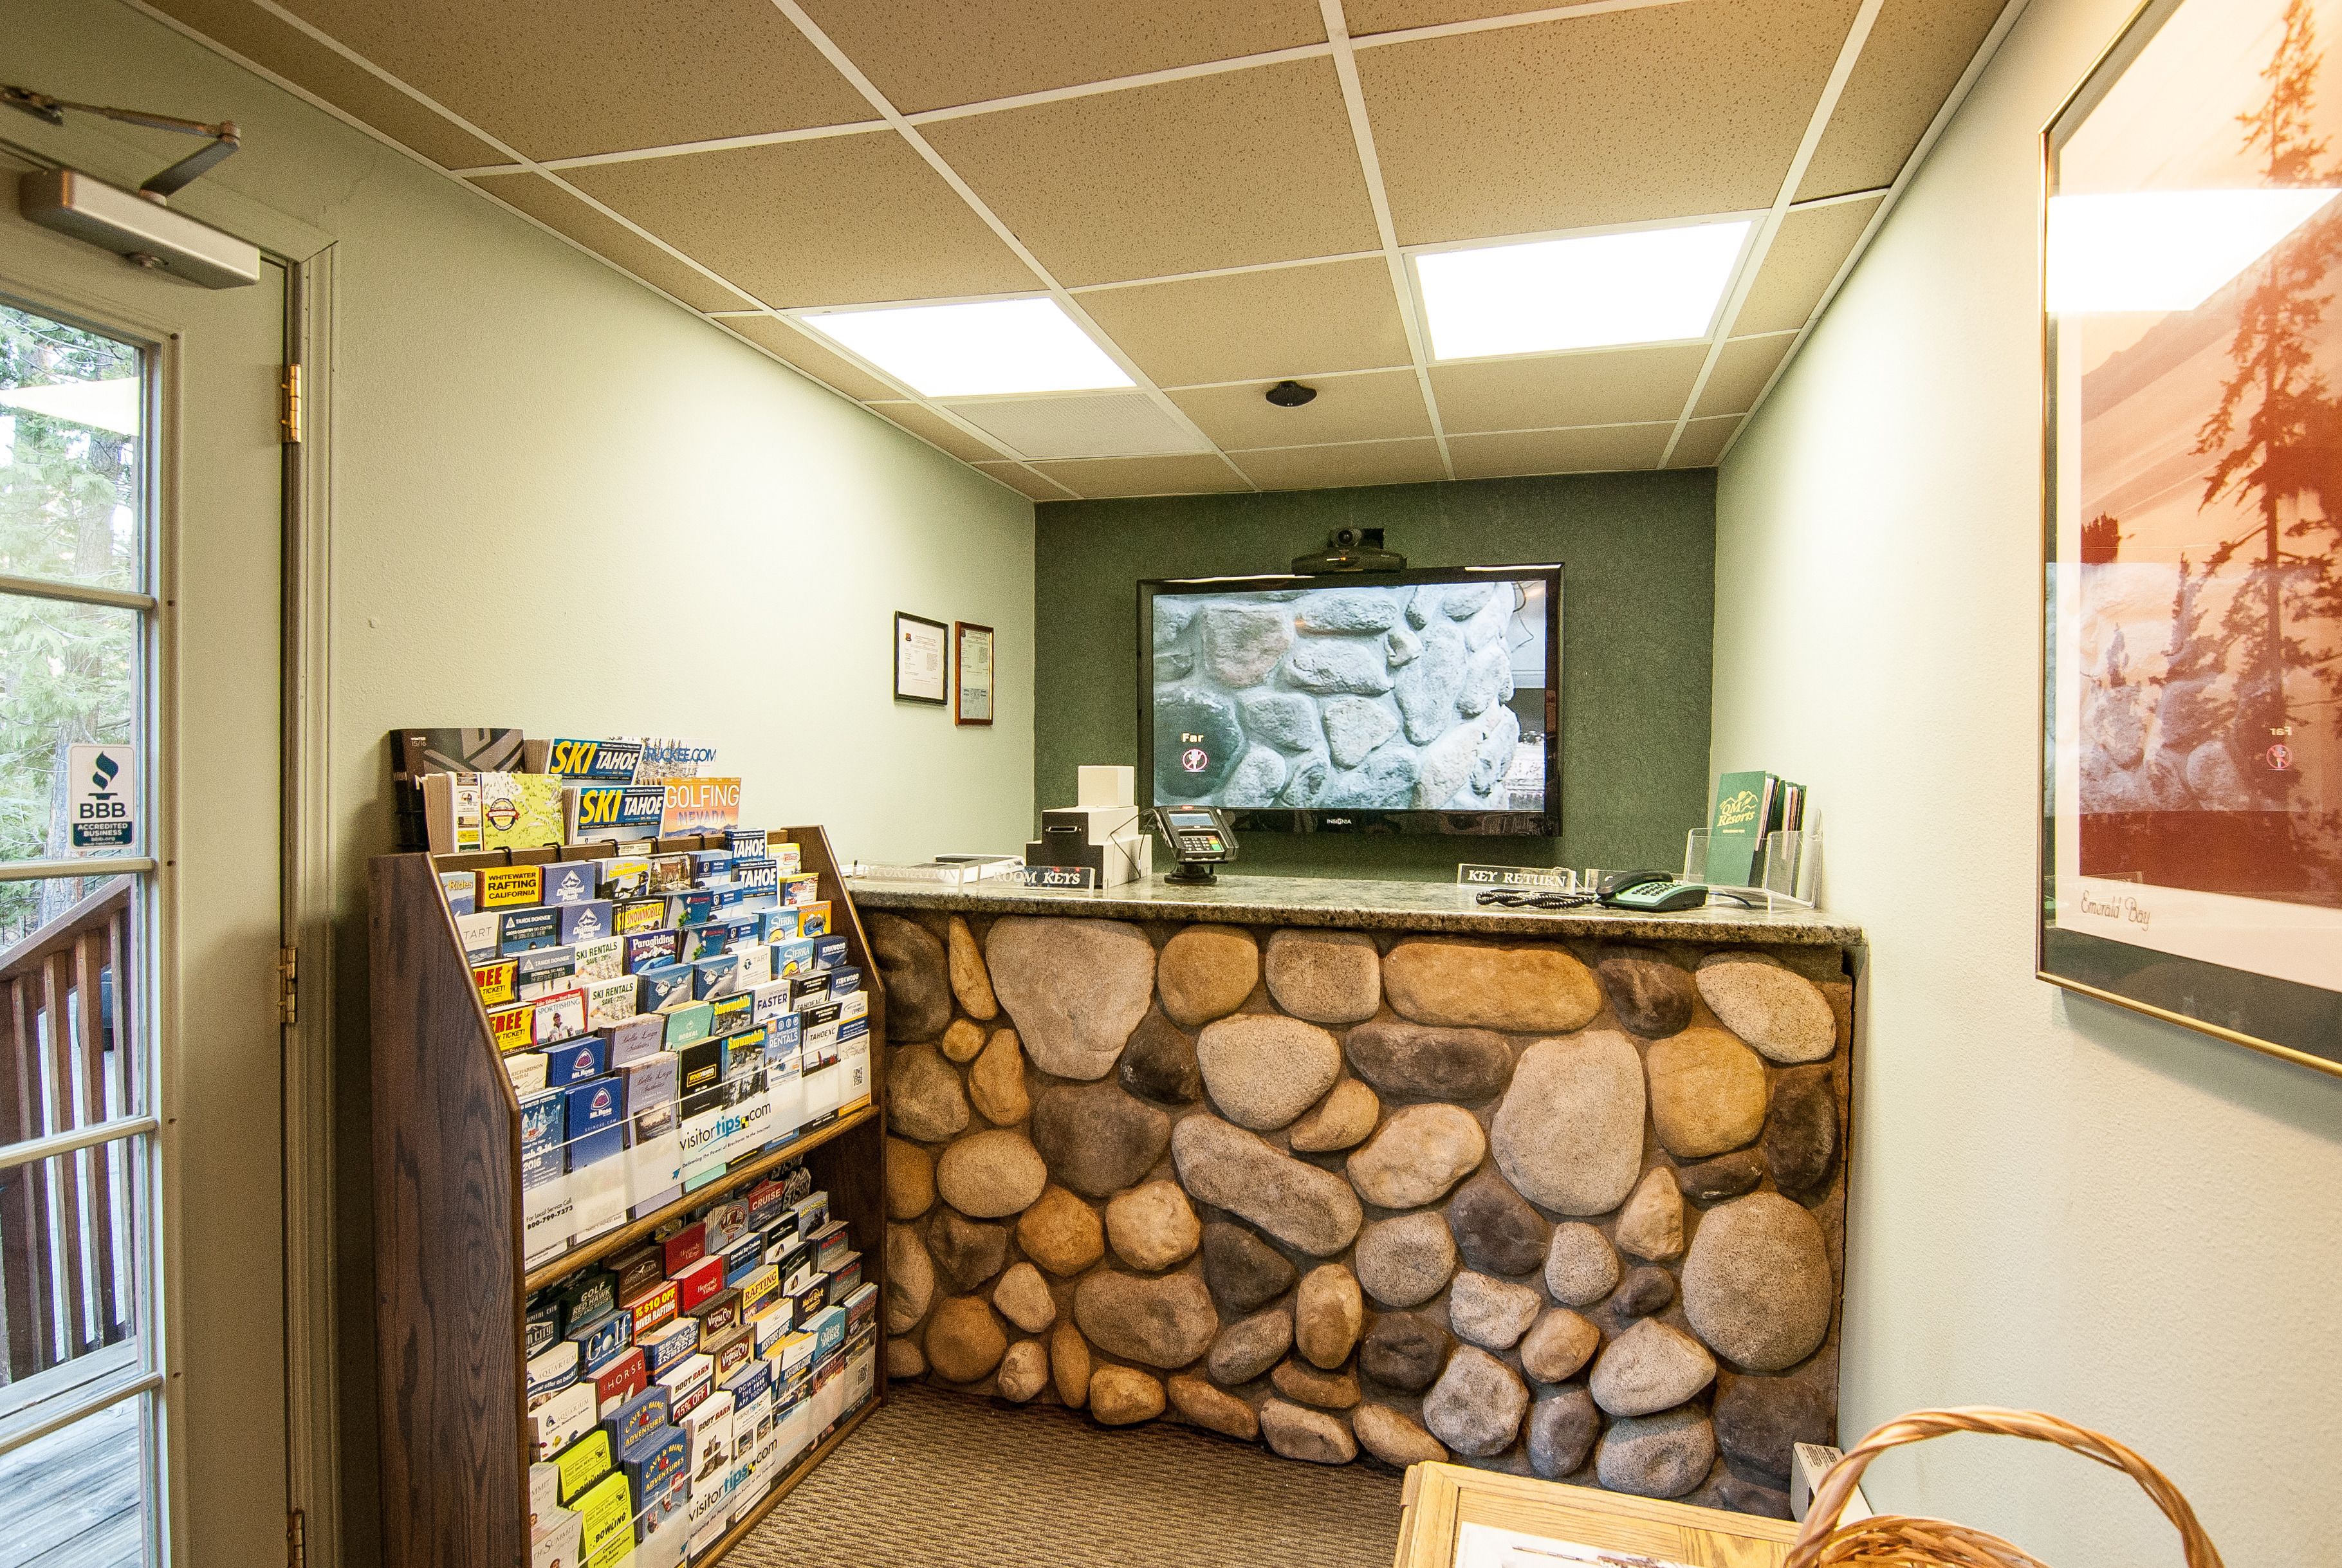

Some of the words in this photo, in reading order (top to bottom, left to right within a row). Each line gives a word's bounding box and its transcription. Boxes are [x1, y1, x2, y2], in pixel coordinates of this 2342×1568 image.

[1182, 732, 1204, 742] Far
[551, 741, 597, 774] SKI
[596, 751, 639, 770] TAHOE
[623, 796, 663, 816] TAHOE
[665, 784, 739, 808] GOLFING
[80, 802, 126, 818] BBB
[580, 789, 623, 824] SKI
[1722, 802, 1742, 816] QM
[678, 809, 726, 826] NEVADA
[1717, 811, 1755, 827] Resorts
[733, 838, 764, 858] TAHOE
[488, 872, 536, 880] WHITEWATER
[609, 863, 649, 878] Snowmobile
[740, 868, 776, 888] TAHOE
[863, 866, 957, 880] INFORMATION
[993, 870, 1037, 883] ROOM
[1043, 871, 1081, 885] KEYS
[1467, 869, 1498, 882] KEY
[1502, 872, 1567, 887] RETURN
[448, 880, 473, 891] Rides
[488, 880, 536, 890] RAFTING
[489, 890, 535, 899] CALIFORNIA
[557, 885, 584, 897] Diamond
[627, 905, 663, 924] SNOWMOBILE!
[2081, 890, 2122, 919] Emerald
[2125, 896, 2150, 932] Bay
[463, 927, 492, 940] TART
[573, 923, 601, 935] Diamond
[576, 950, 587, 961] SKI
[589, 941, 618, 957] RENTALS
[632, 935, 675, 950] Paragliding
[822, 943, 845, 954] KIRKWOOD
[753, 953, 768, 963] TART
[475, 966, 503, 988] REE
[836, 973, 859, 985] KIRKWOOD
[483, 985, 505, 994] TICKET!
[593, 989, 604, 1000] SKI
[605, 982, 634, 997] RENTALS
[538, 999, 580, 1015] SPORTFISHING
[714, 995, 751, 1016] Snowmobile
[757, 993, 788, 1010] FASTER
[490, 1011, 522, 1033] FREE
[503, 1029, 525, 1039] TICKET!
[678, 1031, 698, 1040] BOREAL
[728, 1029, 765, 1051] Snowmobile
[769, 1032, 798, 1049] RENTALS
[511, 1062, 544, 1076] RICHARDSON
[689, 1067, 715, 1081] WOODWARD
[679, 1102, 771, 1152] visitortips.com
[682, 1156, 702, 1168] Delivering
[710, 1147, 722, 1156] Power
[727, 1138, 745, 1148] Brochures
[523, 1158, 542, 1172] 2016
[535, 1208, 546, 1219] Local
[546, 1203, 562, 1214] Service
[562, 1197, 572, 1207] Call
[752, 1188, 781, 1211] CRUISE
[527, 1204, 573, 1231] 800-799-7373
[582, 1282, 605, 1302] GOLF
[697, 1277, 717, 1293] Heavenly
[745, 1271, 777, 1302] RAFTING
[573, 1302, 587, 1316] RED
[589, 1288, 611, 1307] HAWK
[644, 1296, 660, 1313] $10
[661, 1287, 675, 1304] OFF
[636, 1313, 652, 1331] RIVER
[652, 1300, 676, 1321] RAFTING
[708, 1313, 723, 1328] Virginia
[723, 1307, 733, 1321] City
[587, 1313, 631, 1361] Golf
[658, 1337, 696, 1365] INSIDE
[722, 1350, 739, 1367] Virginia
[738, 1342, 748, 1356] City
[539, 1353, 577, 1379] AQUARIUM
[607, 1360, 643, 1390] HORSE
[528, 1385, 544, 1397] pecial
[544, 1379, 555, 1388] offer
[562, 1368, 576, 1382] back!
[675, 1376, 692, 1394] BOOT
[693, 1363, 710, 1383] BARN
[738, 1368, 768, 1394] DOWNLOAD
[742, 1387, 751, 1397] THE
[753, 1378, 766, 1391] FREE
[675, 1399, 692, 1419] 15%
[692, 1387, 707, 1405] OFF
[739, 1397, 750, 1408] APP
[750, 1383, 768, 1399] TODAY!
[557, 1398, 589, 1421] AQUARIUM
[625, 1410, 641, 1434] CAVE
[648, 1400, 665, 1410] MINE
[697, 1416, 714, 1433] BOOT
[715, 1403, 732, 1421] BARN
[625, 1415, 665, 1447] ADVENTURES
[645, 1455, 661, 1479] CAVE
[668, 1443, 684, 1453] MINE
[645, 1455, 685, 1491] ADVENTURES
[688, 1439, 778, 1523] visitortips.com
[717, 1503, 729, 1517] Power
[543, 1520, 575, 1554] SUMMIT
[595, 1511, 627, 1544] BOWLING
[593, 1554, 608, 1568] Family
[608, 1536, 631, 1555] Recreation
[602, 1536, 622, 1554] Complete
[605, 1551, 620, 1563] Center
